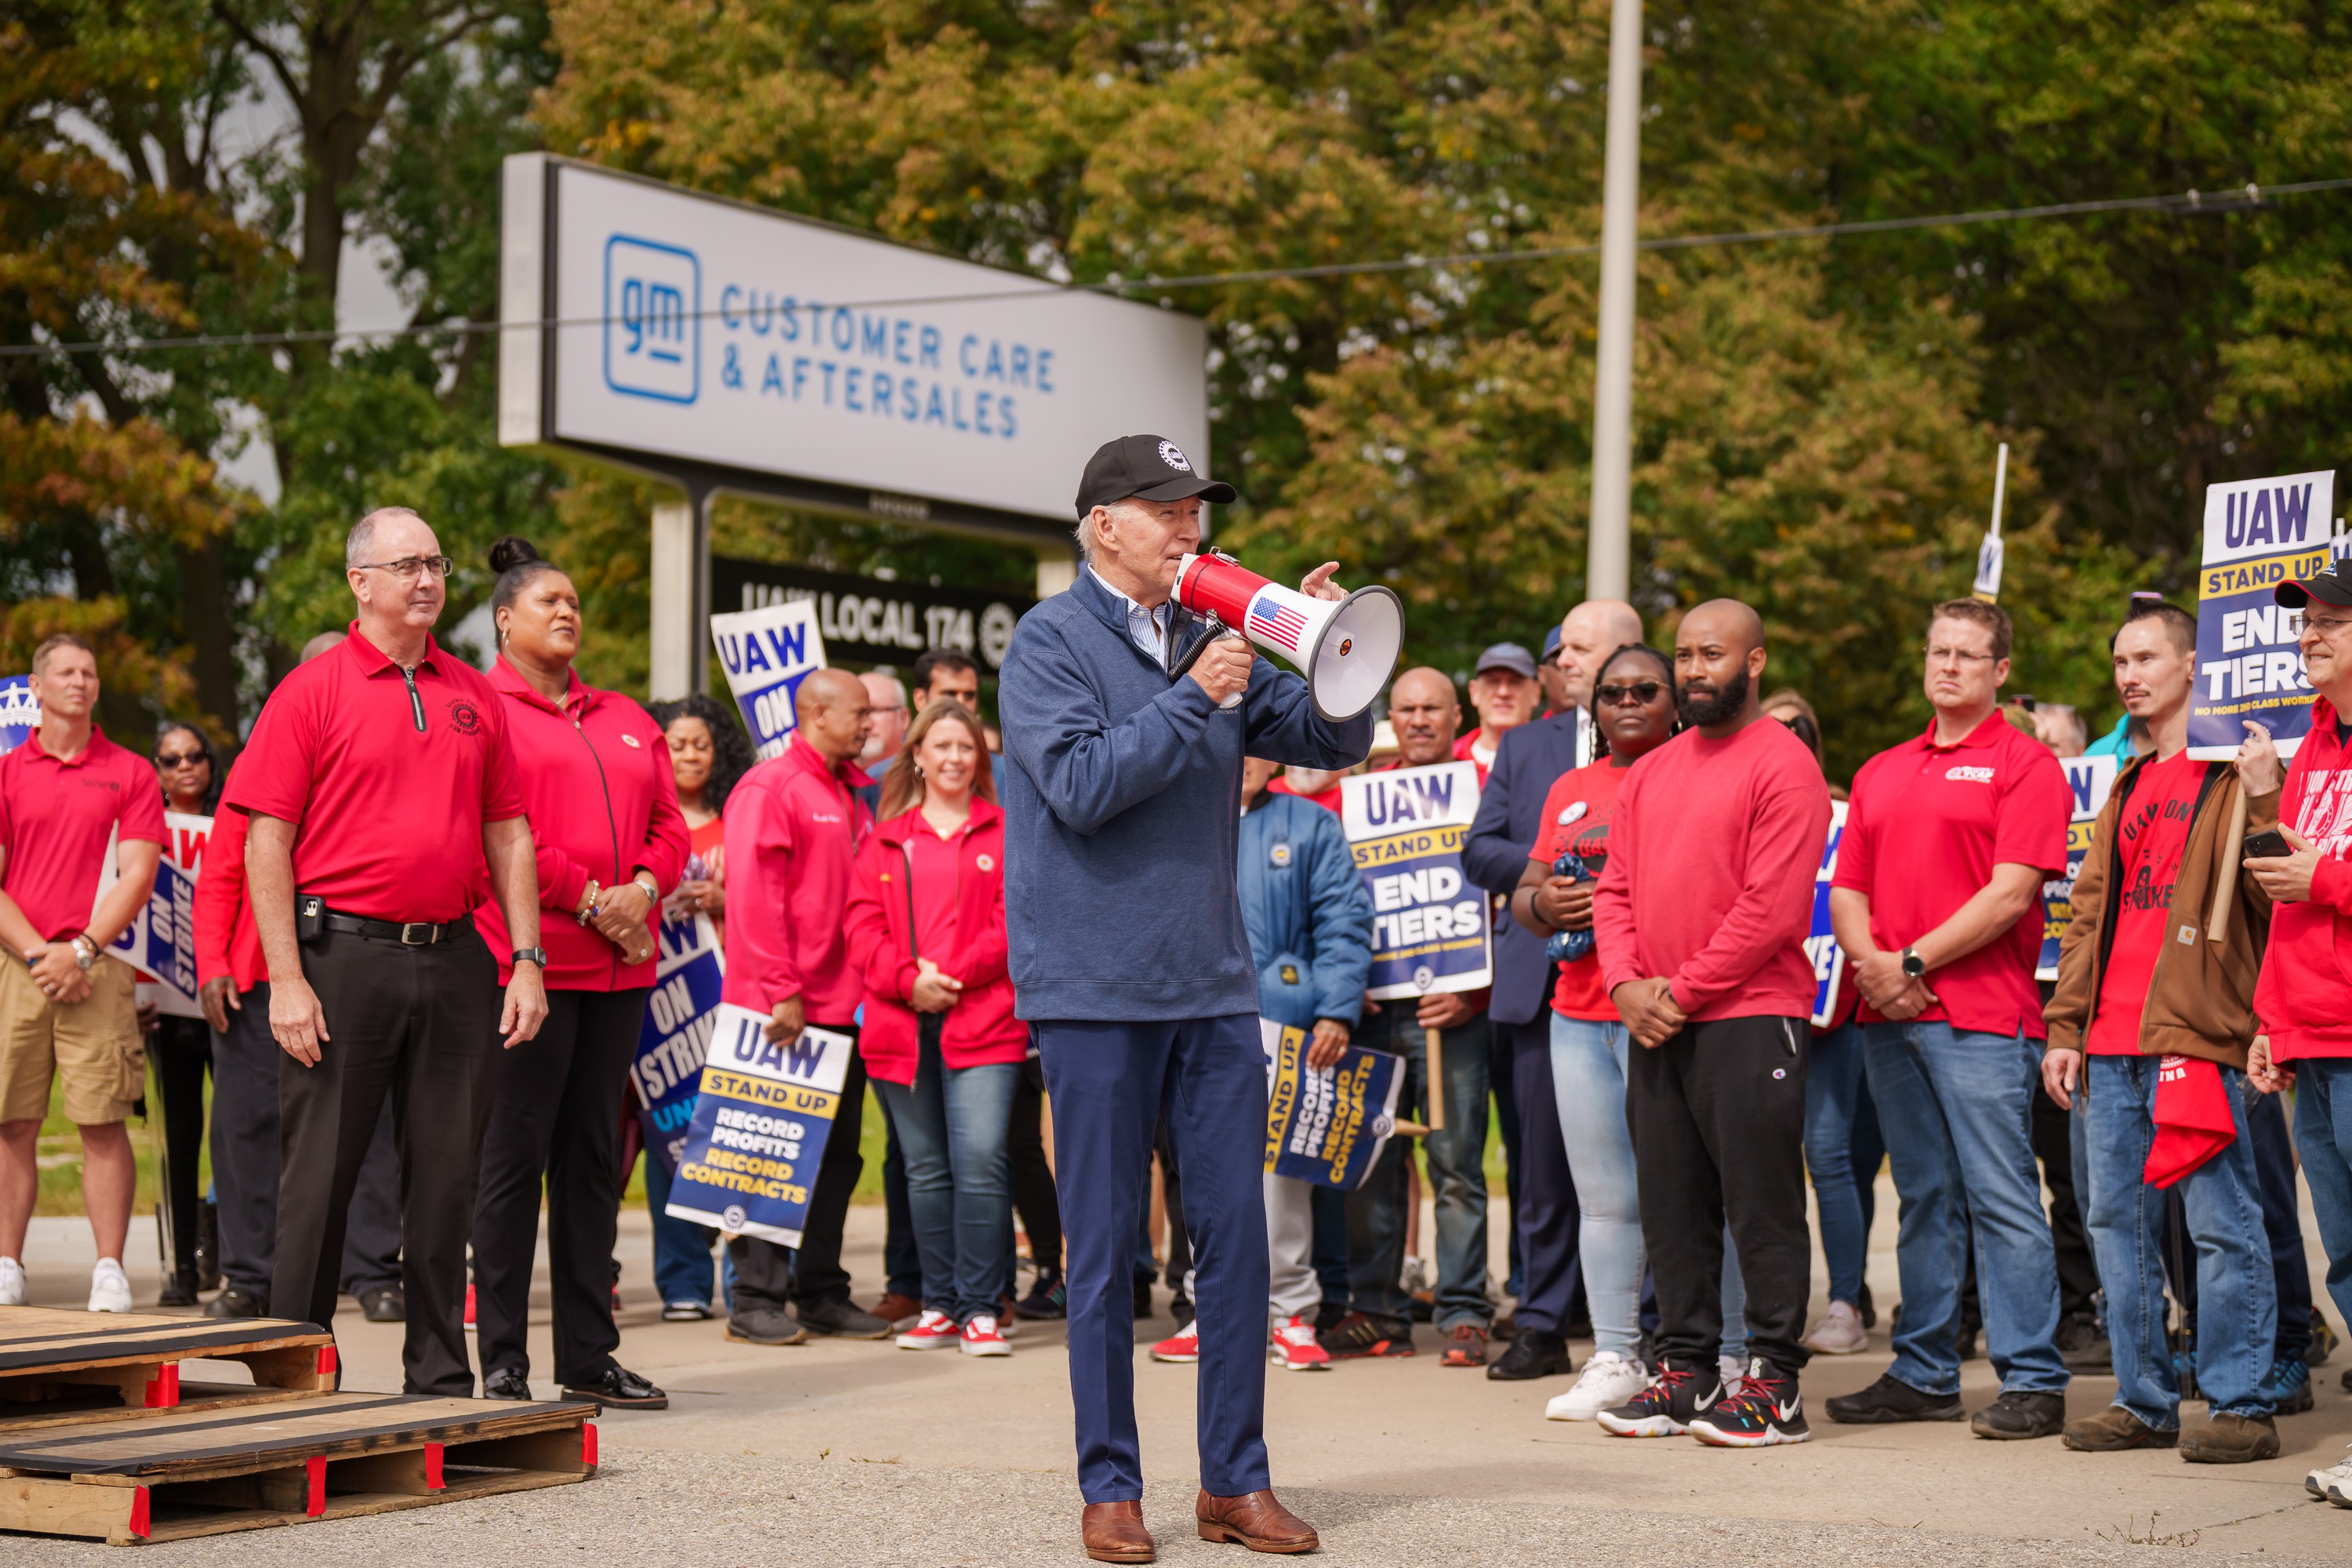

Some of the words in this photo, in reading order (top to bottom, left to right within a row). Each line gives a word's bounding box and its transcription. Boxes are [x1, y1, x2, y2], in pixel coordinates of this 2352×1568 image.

[622, 277, 684, 354] gm
[720, 283, 942, 369] CUSTOMER
[960, 333, 1057, 393] CARE
[720, 342, 746, 392] &
[760, 352, 1020, 439] AFTERSALES
[2225, 482, 2313, 549] UAW
[2208, 562, 2285, 593] STAND
[2294, 555, 2323, 579] UP
[718, 621, 806, 675] UAW
[821, 591, 924, 650] LOCAL
[924, 604, 975, 653] 174
[2222, 604, 2305, 654] END
[753, 684, 795, 739] ON
[2194, 706, 2211, 717] NO
[2212, 704, 2239, 716] MORE
[2251, 697, 2281, 710] CLASS
[2281, 693, 2321, 706] WORKE
[1365, 772, 1454, 826] UAW
[2164, 799, 2194, 822] ON
[1356, 837, 1432, 863] STAND
[1442, 829, 1470, 848] UP
[1373, 866, 1462, 913] END
[151, 890, 173, 945] ON
[171, 873, 195, 995] STRIKE
[1372, 900, 1483, 950] TIERS
[649, 974, 695, 1036] ON
[638, 1004, 717, 1099] STRI
[733, 1018, 827, 1080] UAW
[709, 1074, 788, 1104] STAND
[796, 1091, 827, 1111] UP
[1265, 1080, 1293, 1163] STAND
[1283, 1038, 1295, 1071] UP
[1304, 1065, 1335, 1158] PROFITS
[1321, 1069, 1352, 1161] RECORD
[1329, 1054, 1375, 1184] CONTRACTS
[710, 1125, 800, 1160] PROFITS
[716, 1106, 806, 1141] RECORD
[681, 1162, 809, 1205] CONTRACTS
[705, 1147, 794, 1181] RECORD
